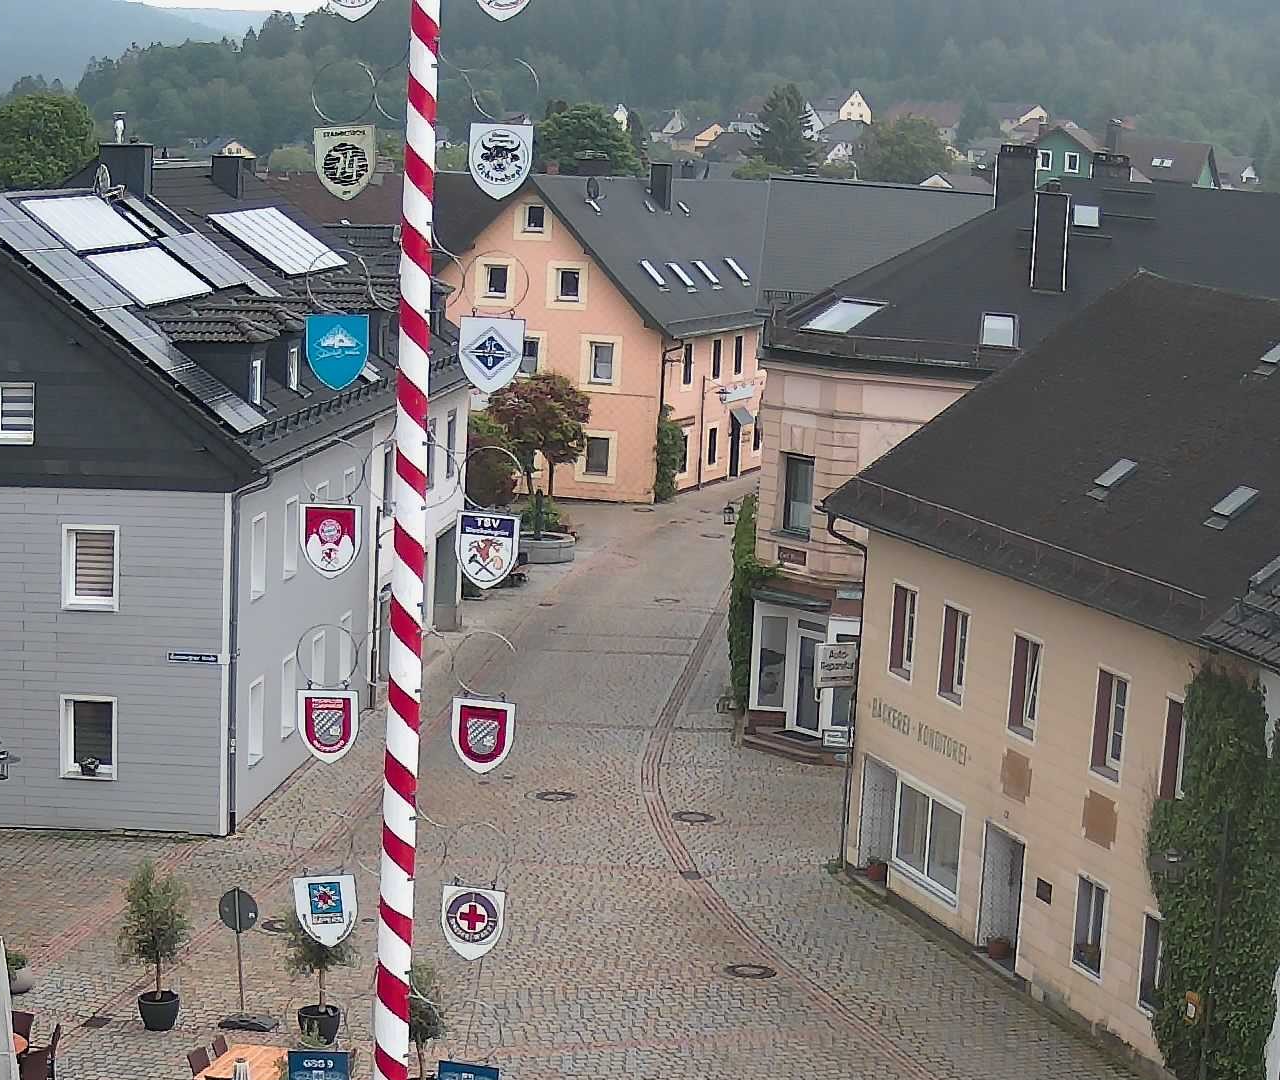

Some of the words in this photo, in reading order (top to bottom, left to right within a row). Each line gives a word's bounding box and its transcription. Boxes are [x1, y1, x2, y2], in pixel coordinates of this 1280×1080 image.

[474, 517, 500, 529] TSV
[917, 721, 967, 767] KONDITOREI
[303, 1059, 326, 1068] GSG
[327, 1060, 334, 1068] 9
